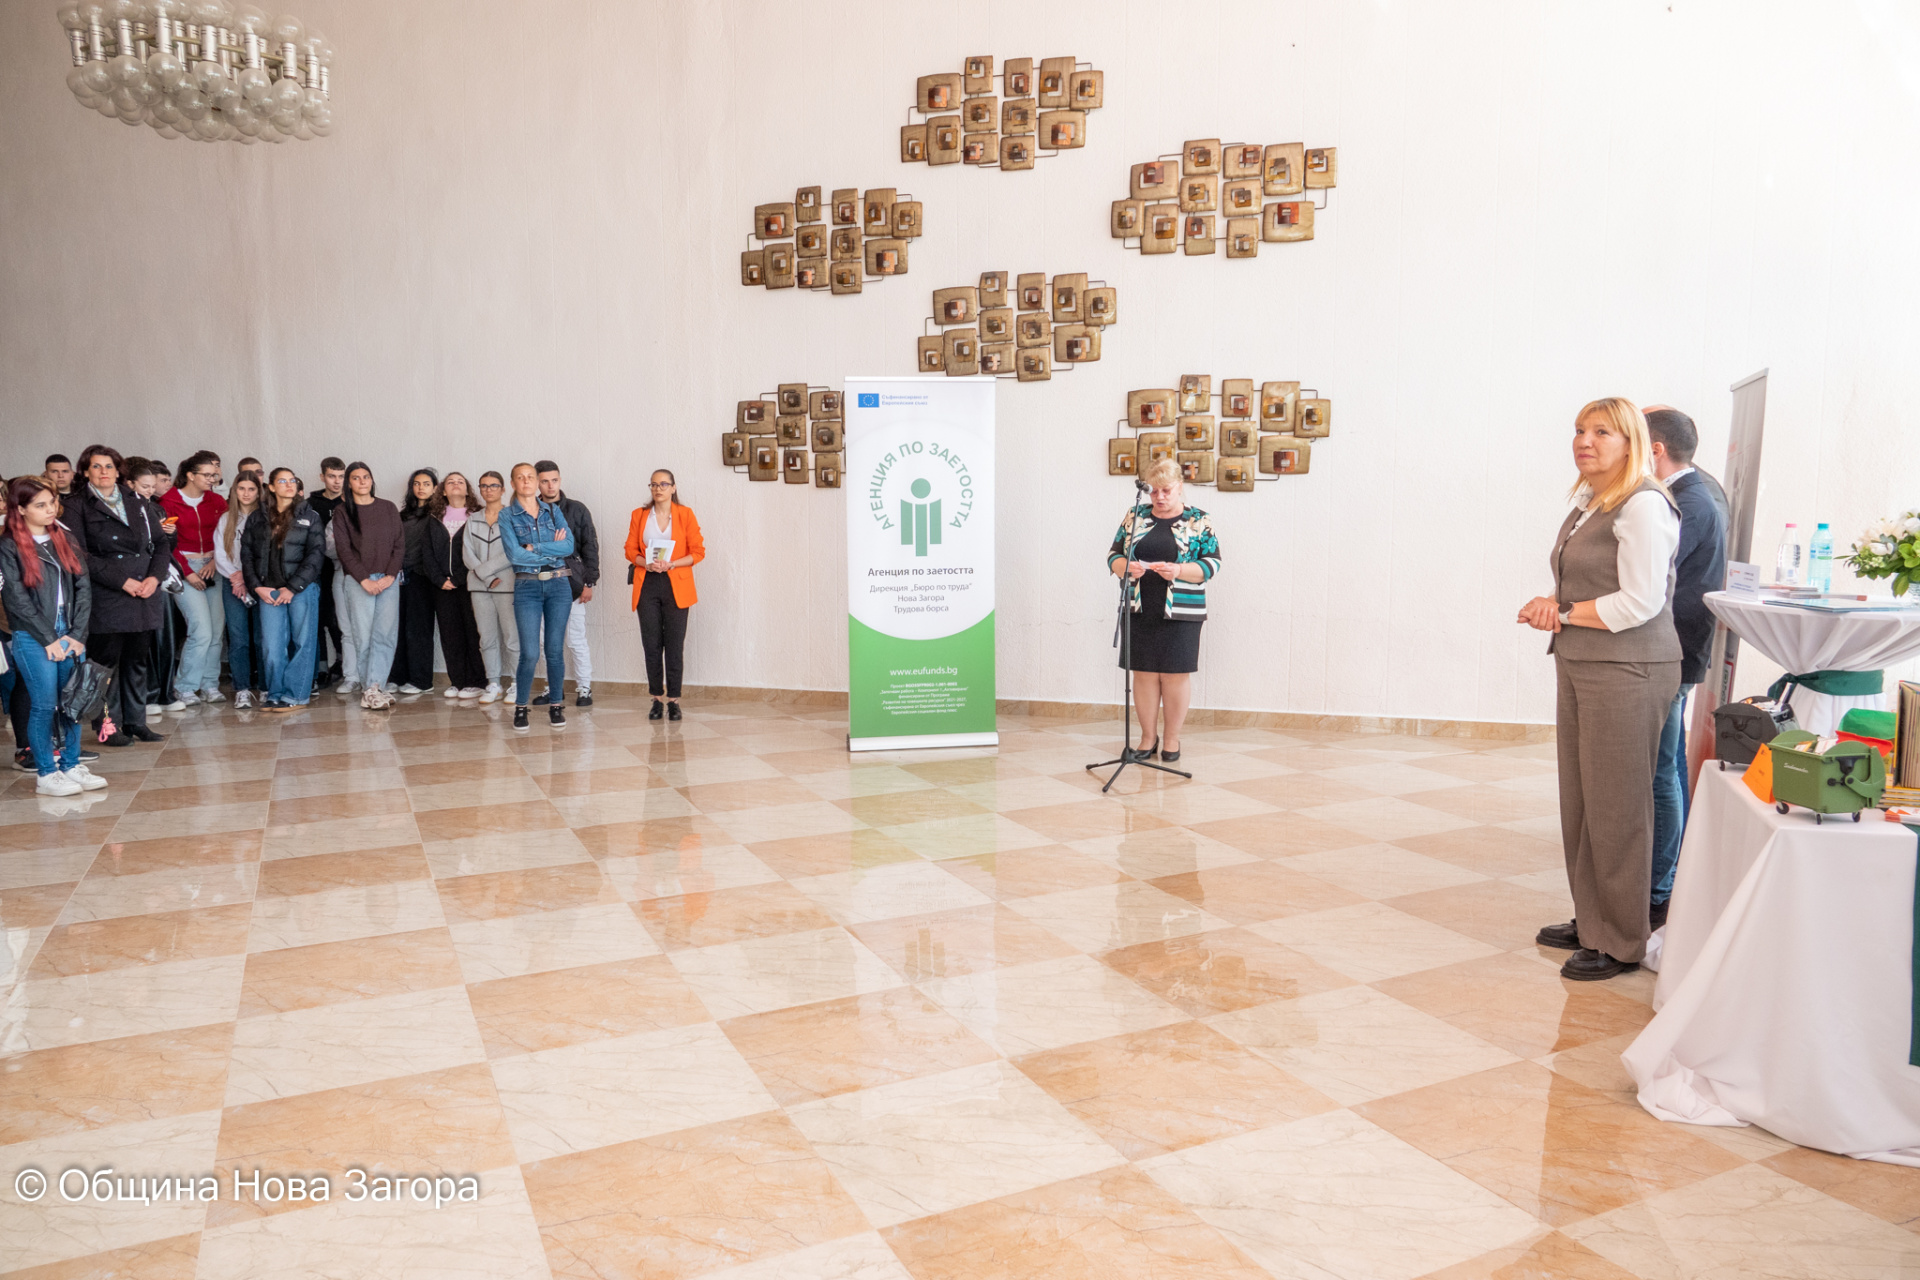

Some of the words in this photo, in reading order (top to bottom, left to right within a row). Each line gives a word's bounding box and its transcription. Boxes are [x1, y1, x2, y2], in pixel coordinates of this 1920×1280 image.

[870, 452, 897, 530] АГЕНЦИЯ
[899, 441, 923, 458] ПО
[929, 442, 973, 528] ЗАЕТОСТТА
[868, 568, 910, 577] Агенция
[912, 568, 924, 576] по
[926, 567, 974, 575] заетостта
[869, 584, 909, 594] Дирекция
[919, 594, 945, 602] Загора
[894, 605, 924, 614] Трудова
[926, 604, 949, 613] борса
[889, 666, 958, 676] www.eufunds.bg
